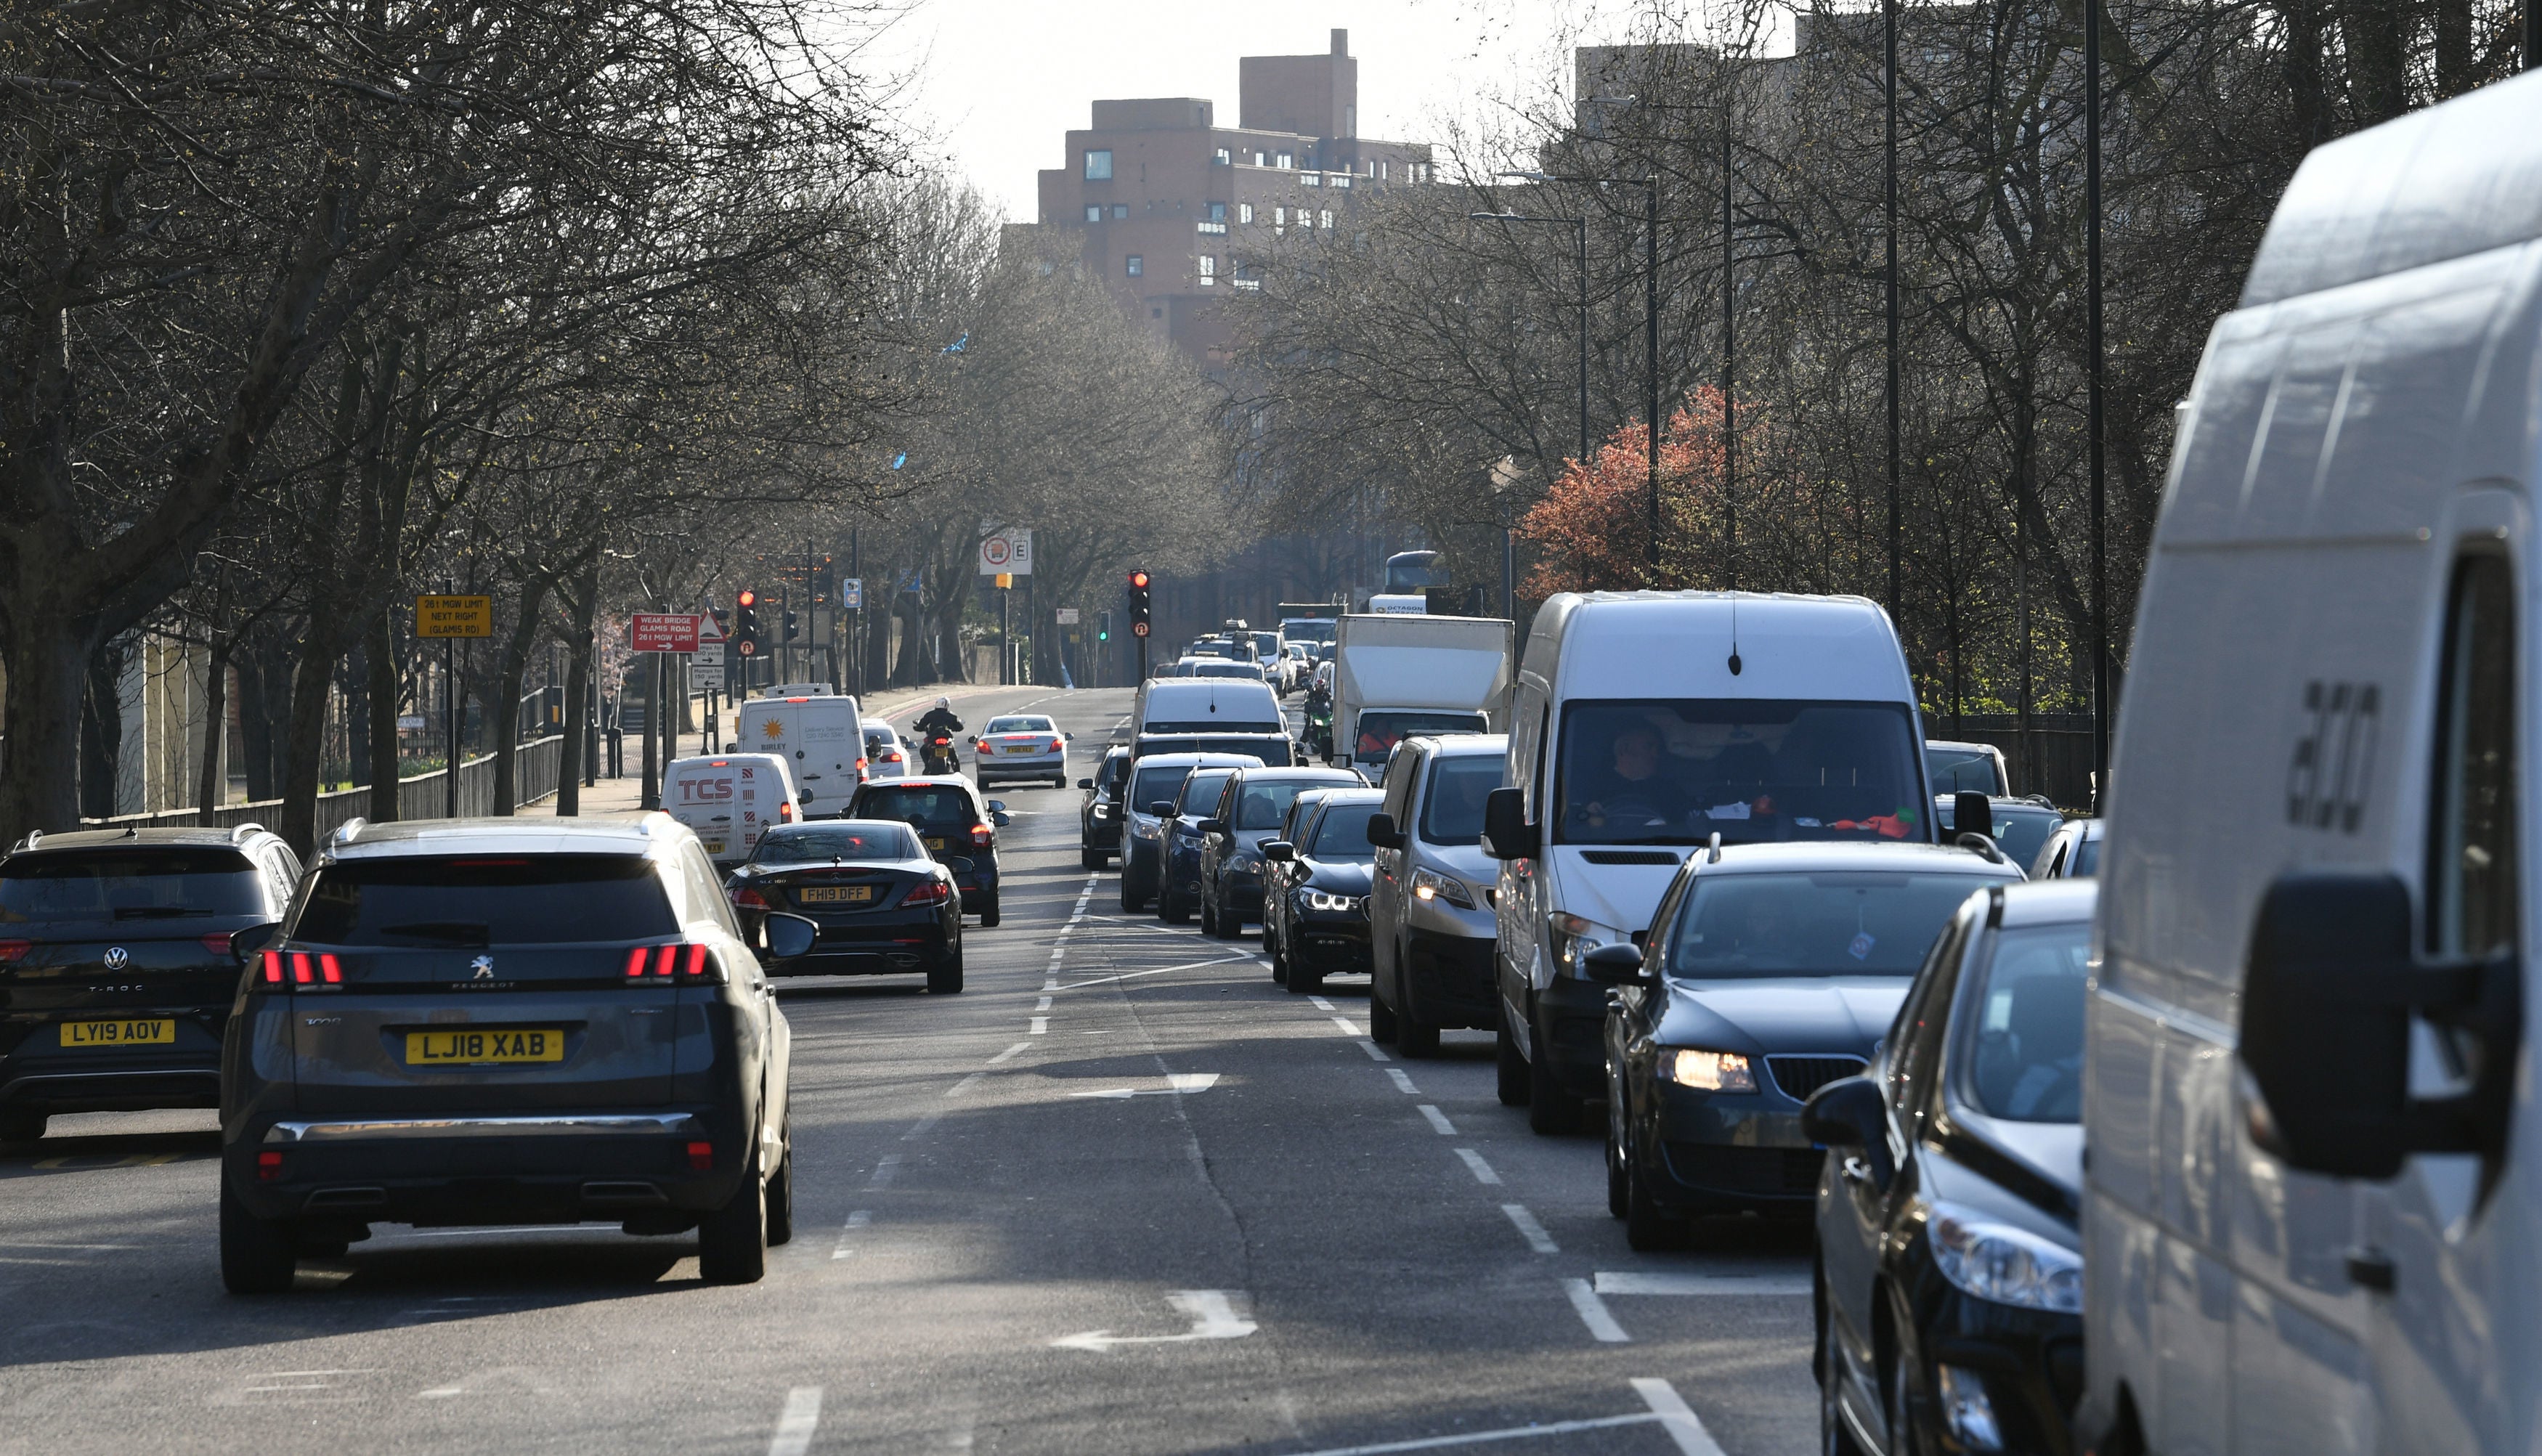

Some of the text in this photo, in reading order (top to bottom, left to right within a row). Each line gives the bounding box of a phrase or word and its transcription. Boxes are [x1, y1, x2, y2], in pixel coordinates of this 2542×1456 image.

[1017, 545, 1025, 557] E
[429, 625, 479, 634] (GLAMIS RD)
[678, 778, 733, 800] TCS
[808, 887, 864, 900] FH19 DFF
[73, 1022, 162, 1041] LY19 AOV
[423, 1033, 545, 1059] LJ18 XAB
